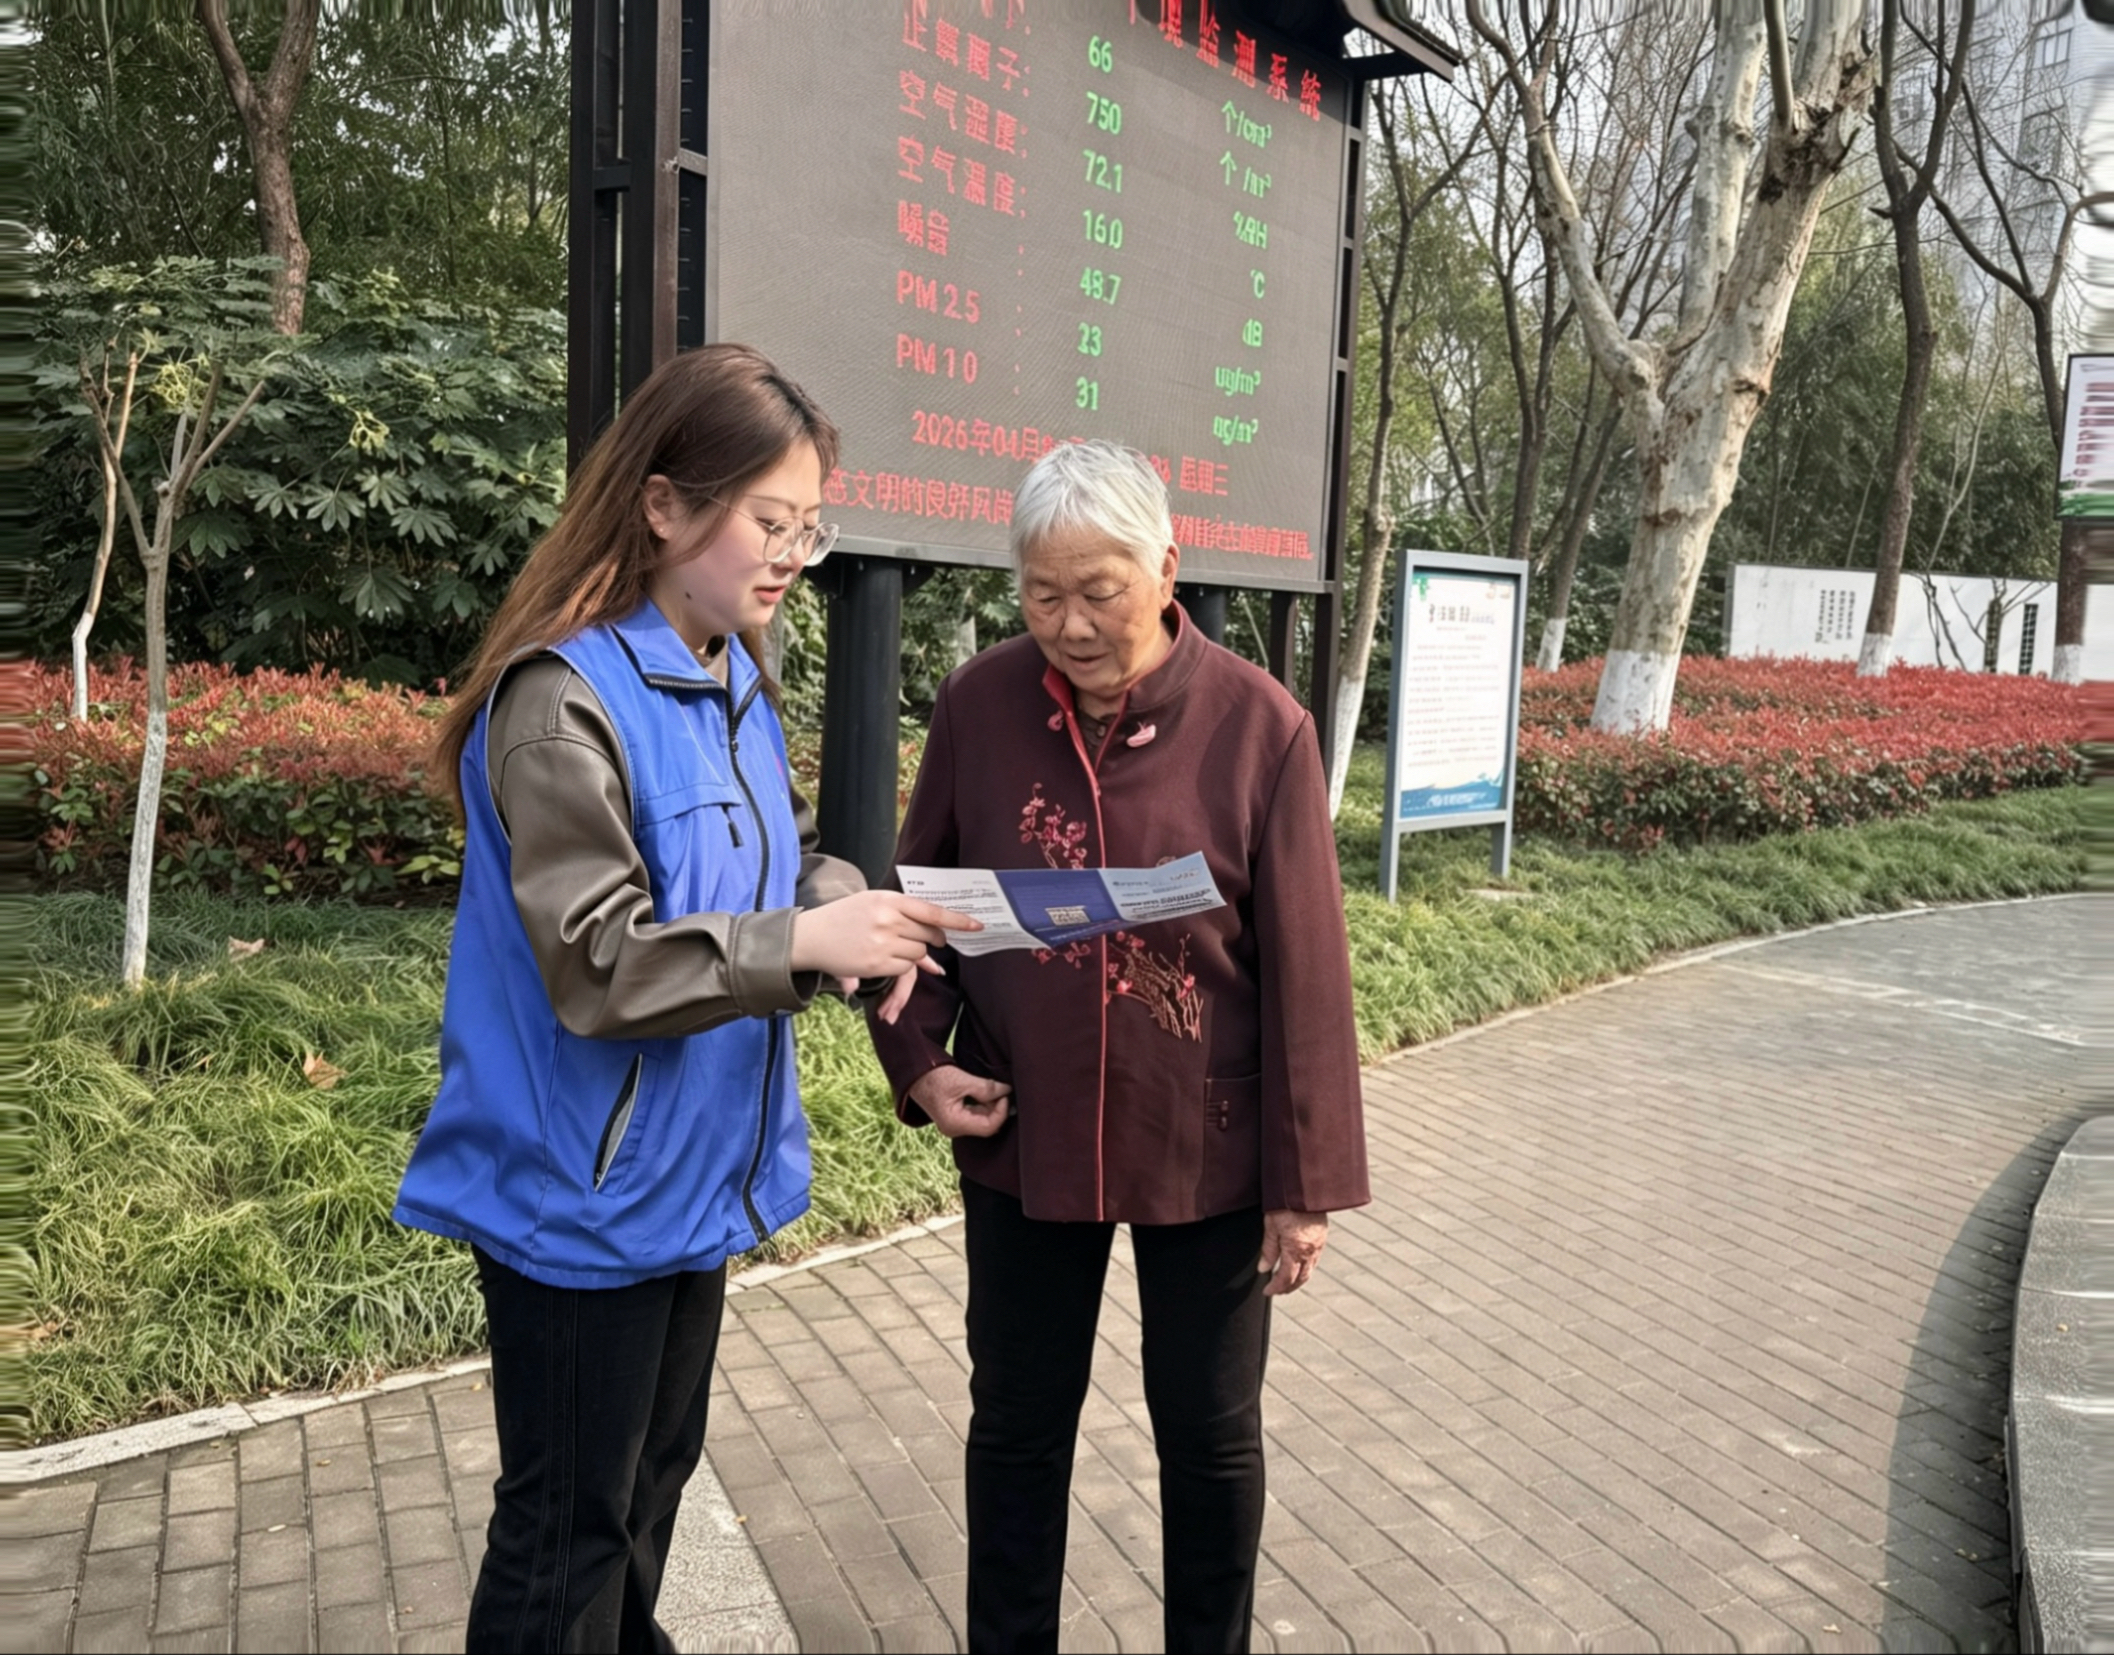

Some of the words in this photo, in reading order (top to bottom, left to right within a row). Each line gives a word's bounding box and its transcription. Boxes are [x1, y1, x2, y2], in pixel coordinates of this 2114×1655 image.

[1087, 35, 1113, 73] 66
[1086, 91, 1121, 135] 750
[1077, 322, 1102, 357] 23
[1242, 319, 1263, 347] dB
[1076, 377, 1098, 411] 31
